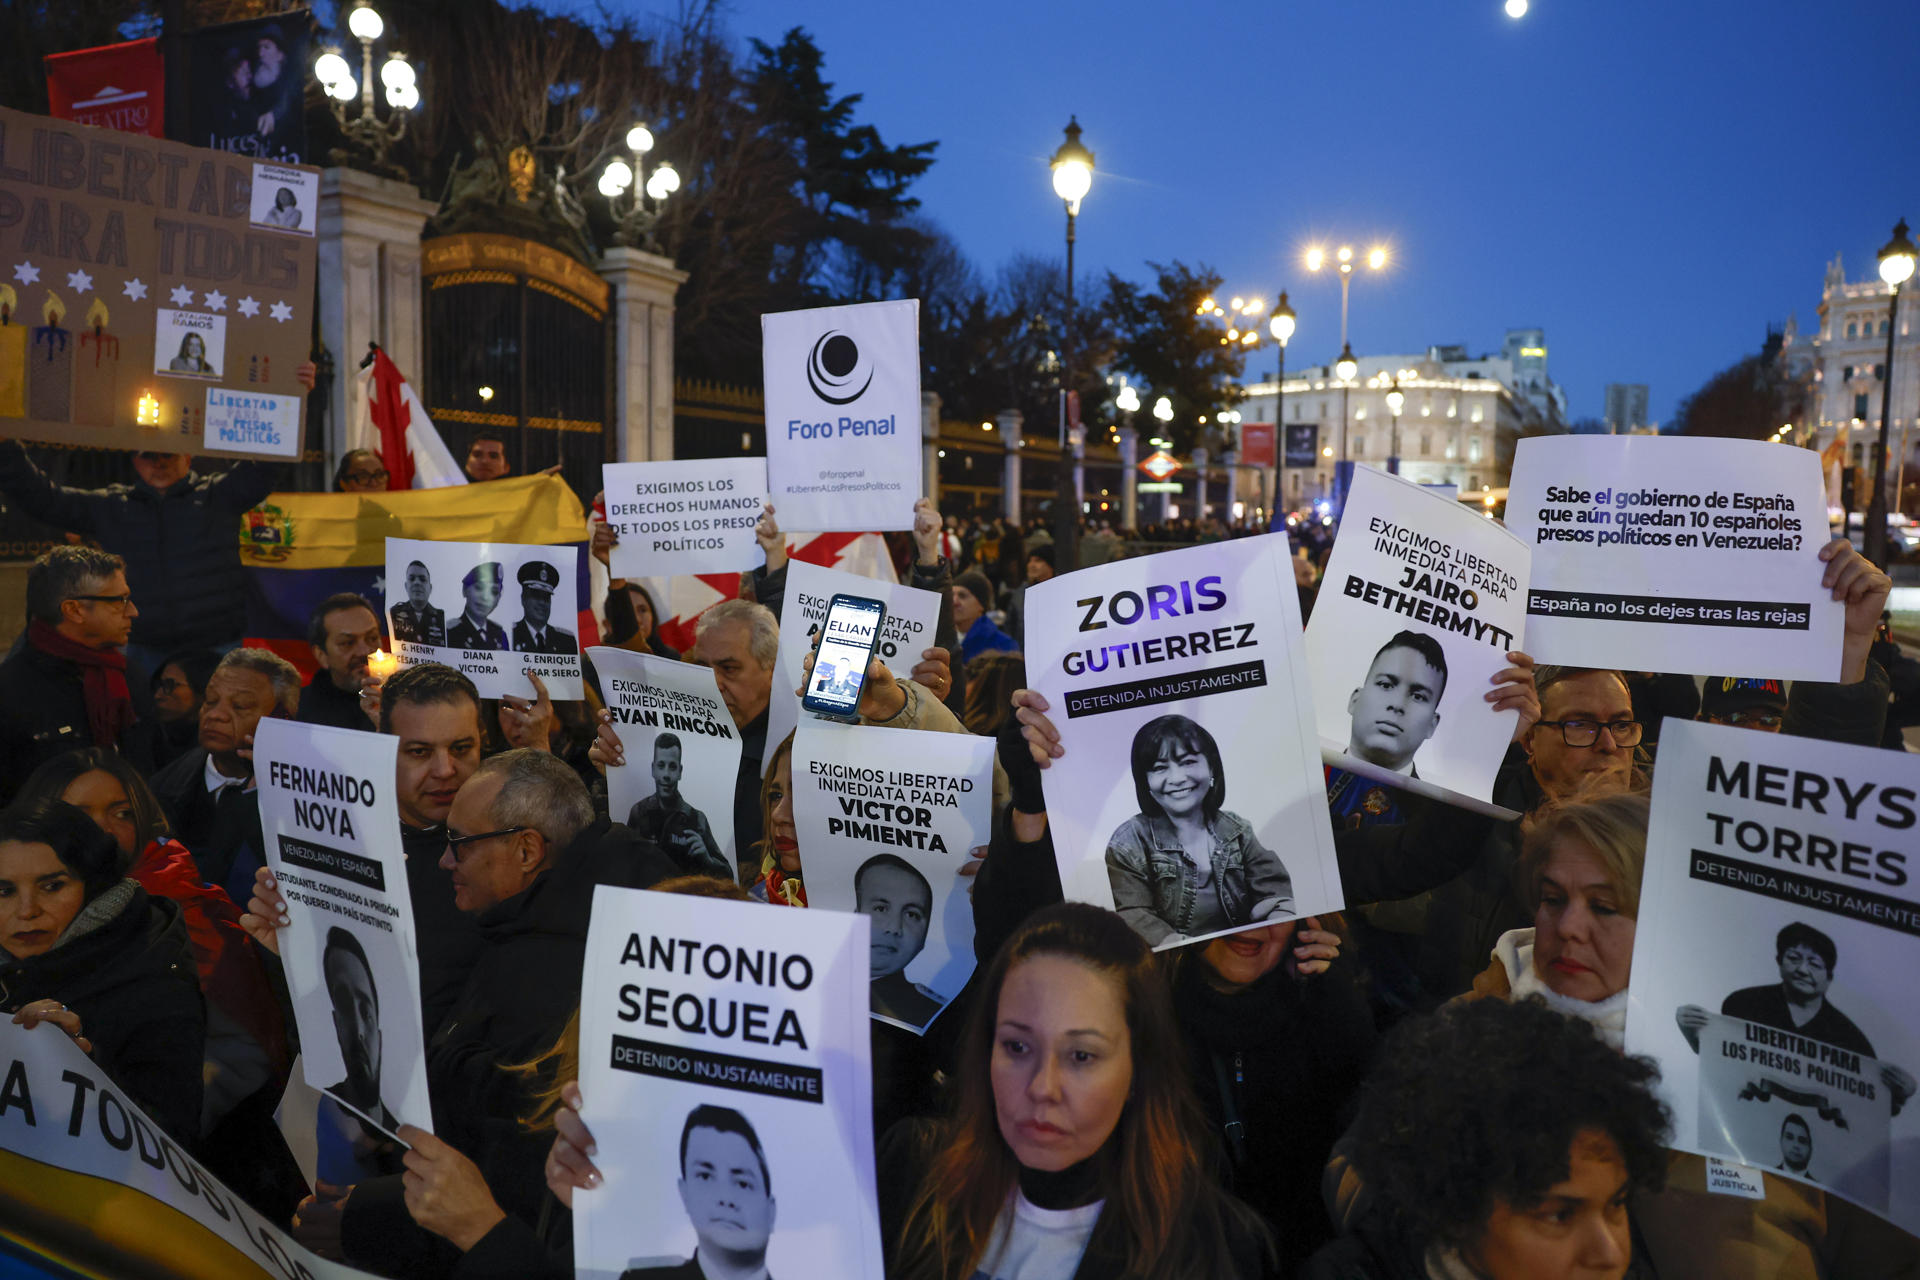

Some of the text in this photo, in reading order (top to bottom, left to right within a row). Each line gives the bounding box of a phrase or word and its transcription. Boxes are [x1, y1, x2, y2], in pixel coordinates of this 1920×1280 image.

[0, 118, 250, 220] LIBERTAD
[154, 216, 300, 291] TODOS
[172, 319, 214, 330] RAMOS
[233, 418, 274, 432] PRESOS
[788, 414, 896, 440] Foro Penal
[636, 479, 734, 495] EXIGIMOS LOS
[819, 469, 865, 481] @foropenal
[612, 497, 760, 516] DERECHOS HUMANOS
[1546, 486, 1795, 513] Sabe el gobierno de España
[612, 523, 628, 535] DE
[632, 521, 680, 534] TODOS
[684, 519, 710, 531] LOS
[1538, 506, 1802, 534] que aún quedan 10 españoles
[653, 536, 725, 552] POLÍTICOS
[1368, 516, 1519, 592] EXIGIMOS LIBERTAD
[1536, 526, 1803, 551] presos políticos en Venezuela?
[1374, 536, 1508, 603] INMEDIATA PARA
[1076, 575, 1228, 633] ZORIS
[1398, 566, 1479, 611] JAIRO
[1343, 574, 1514, 652] BETHERMYTT
[1529, 595, 1807, 625] España no los dejes tras las rejas
[410, 644, 435, 655] HENRY
[881, 627, 910, 644] ARA
[1062, 622, 1259, 676] GUTIERREZ
[458, 664, 499, 675] VICTORA
[463, 651, 494, 661] DIANA
[523, 654, 577, 666] G. ENRIQUE
[552, 668, 581, 679] SIERO
[612, 679, 718, 710] EXIGIMOS LIBERTAD
[619, 693, 716, 721] INMEDIATA PARA
[1070, 669, 1262, 712] DETENIDA INJUSTAMENTE
[609, 706, 733, 740] EVAN RINCÓN
[270, 760, 376, 808] FERNANDO
[809, 760, 974, 793] EXIGIMOS LIBERTAD
[818, 777, 958, 808] INMEDIATA PARA
[1706, 755, 1917, 830] MERYS
[294, 797, 355, 841] NOYA
[838, 796, 932, 828] VICTOR
[828, 817, 948, 854] PIMIENTA
[1706, 812, 1908, 887] TORRES
[282, 842, 379, 880] VENEZOLANO Y ESPAÑOL
[318, 882, 364, 907] CONDENADO
[364, 897, 370, 907] A
[370, 899, 399, 918] PRISIÓN
[1695, 859, 1920, 929] DETENIDA INJUSTAMENTE
[286, 889, 393, 934] POR QUERER UN PAÍS DISTINTO
[619, 932, 814, 991] ANTONIO
[617, 983, 809, 1051] SEQUEA
[1722, 1040, 1747, 1061] LOS
[1750, 1046, 1801, 1076] PRESOS
[1745, 1022, 1861, 1075] LIBERTAD PARA
[614, 1045, 818, 1095] DETENIDO INJUSTAMENTE
[61, 1069, 231, 1222] TODOS
[1711, 1168, 1740, 1179] HAGA
[1712, 1179, 1758, 1192] JUSTICIA
